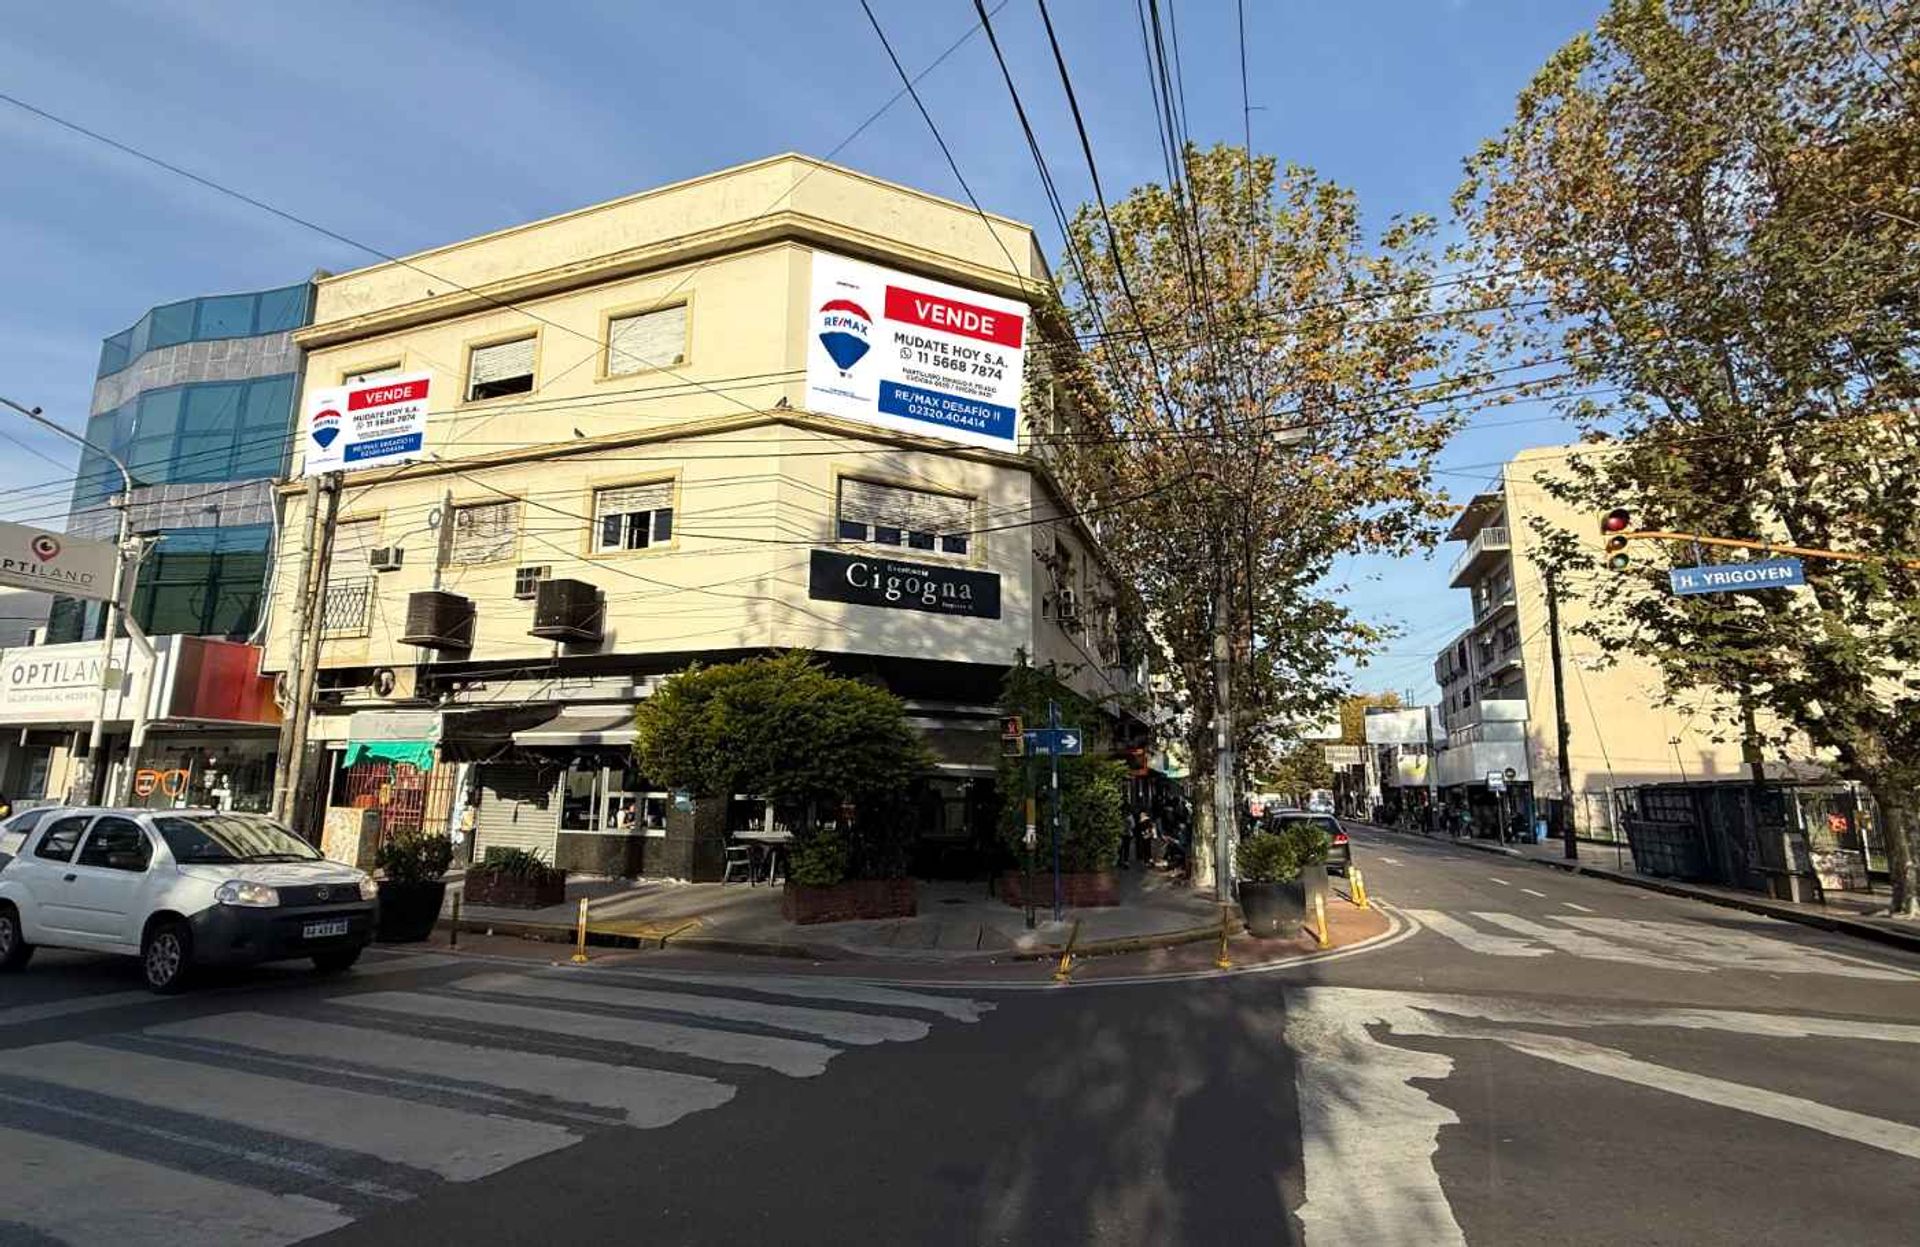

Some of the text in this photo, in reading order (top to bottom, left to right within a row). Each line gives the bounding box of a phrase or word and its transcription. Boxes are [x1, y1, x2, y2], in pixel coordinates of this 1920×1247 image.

[824, 316, 868, 336] RE/MAX
[915, 299, 996, 336] VENDE
[894, 332, 1009, 369] MUDATE HOY S.A.
[917, 351, 929, 364] 11
[932, 354, 967, 373] 5668
[970, 363, 1003, 380] 7874
[365, 386, 413, 405] VENDE
[894, 389, 940, 408] RE/MAX
[908, 404, 986, 428] 02320.404414
[846, 562, 972, 605] Cigogna
[1680, 566, 1793, 588] H. YRIGOYEN
